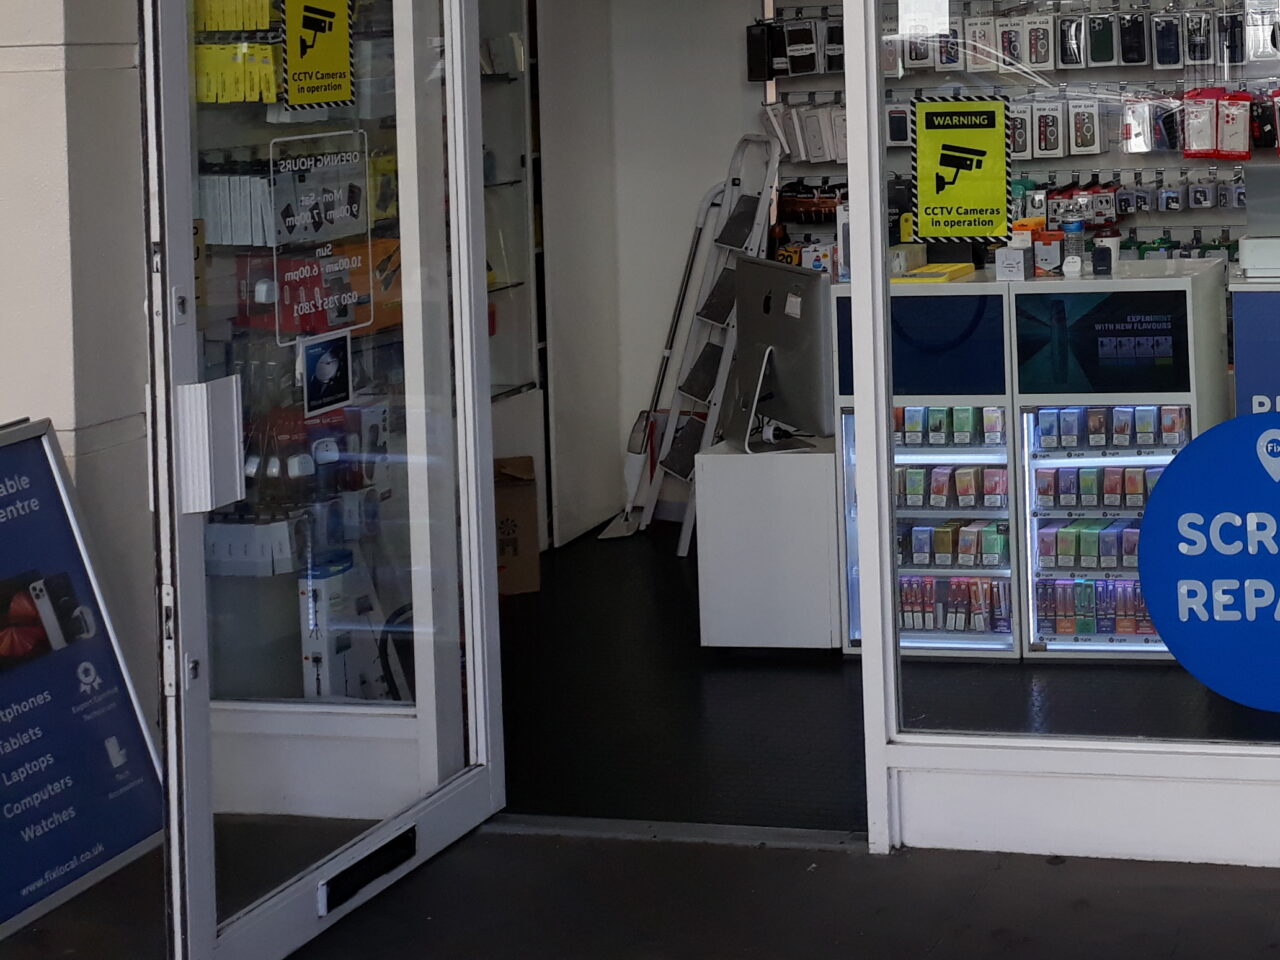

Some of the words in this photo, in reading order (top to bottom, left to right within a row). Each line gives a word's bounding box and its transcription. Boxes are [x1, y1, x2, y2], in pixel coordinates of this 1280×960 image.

[292, 72, 314, 82] CCTV
[315, 71, 347, 81] Cameras
[297, 85, 305, 94] in
[306, 83, 342, 94] operation
[933, 114, 989, 126] WARNING
[924, 206, 953, 217] CCTV
[955, 205, 1001, 217] Cameras
[931, 217, 941, 227] in
[942, 217, 995, 228] operation
[1133, 321, 1172, 330] FLAVOURS
[1, 751, 55, 786] Laptops
[3, 774, 74, 819] Computers
[20, 804, 77, 842] Watches
